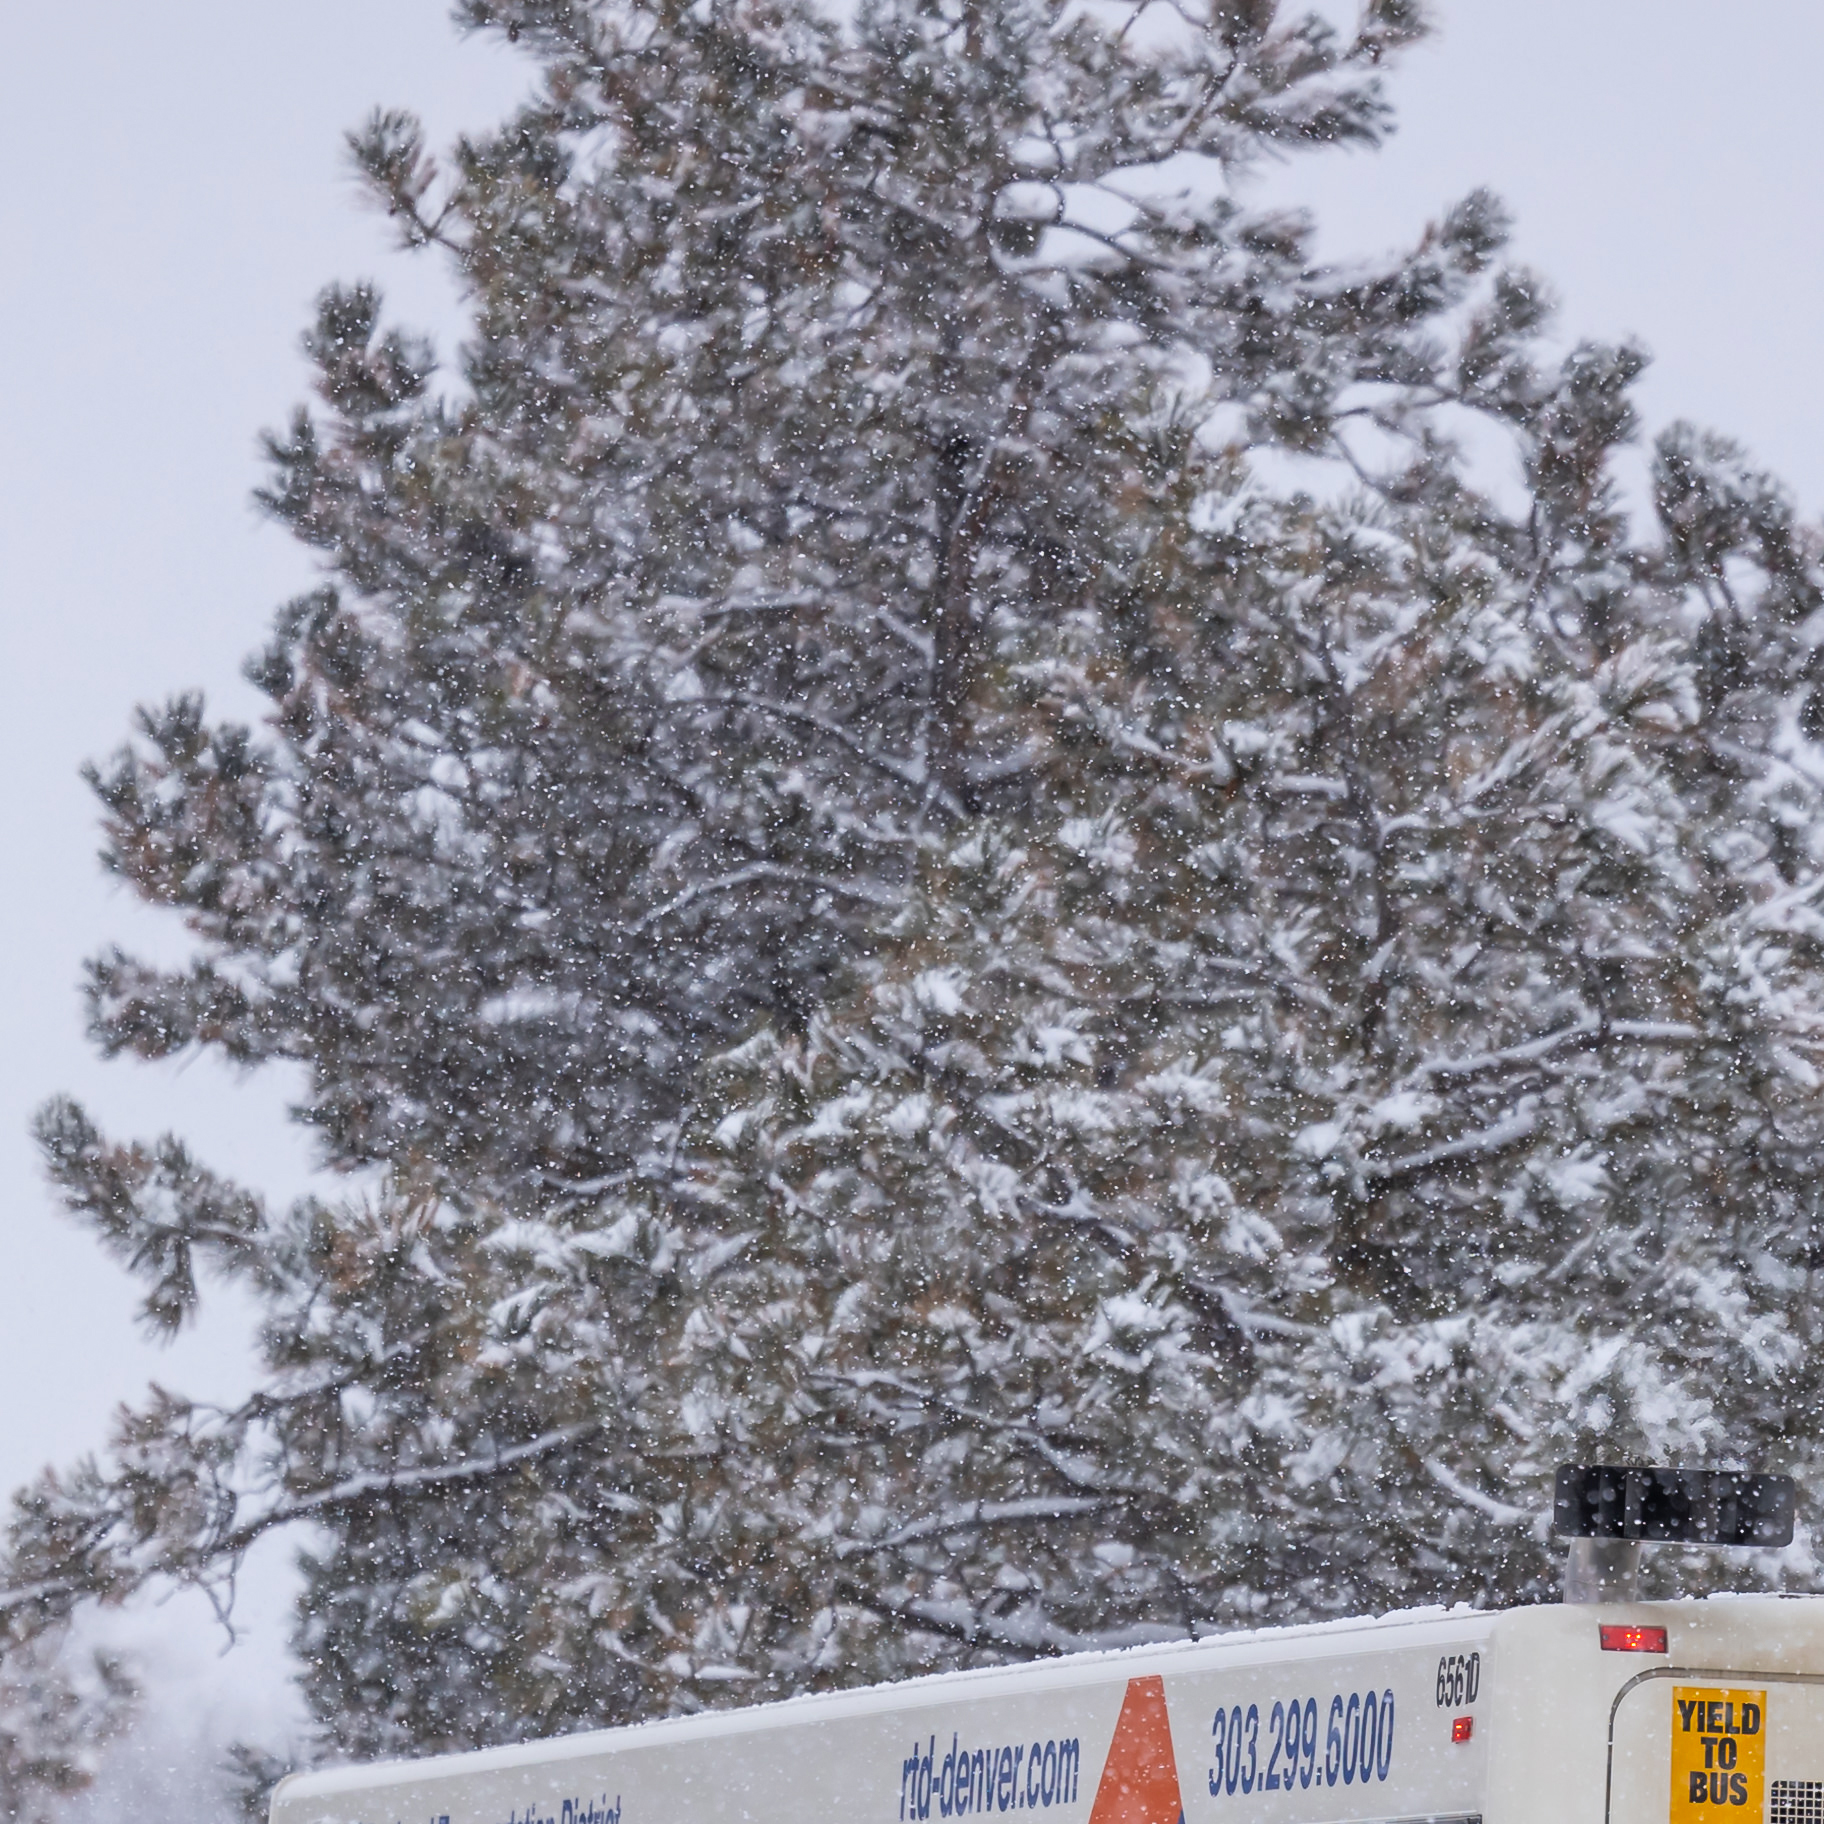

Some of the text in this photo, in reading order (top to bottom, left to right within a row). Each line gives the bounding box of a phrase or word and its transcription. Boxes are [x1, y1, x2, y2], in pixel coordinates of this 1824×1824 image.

[1436, 1652, 1480, 1708] 6561D
[1677, 1699, 1760, 1735] YIELD
[1209, 1688, 1395, 1797] 303.299.6000
[1700, 1736, 1737, 1770] TO
[900, 1731, 1080, 1822] rtd-denver.com
[1689, 1771, 1748, 1806] BUS
